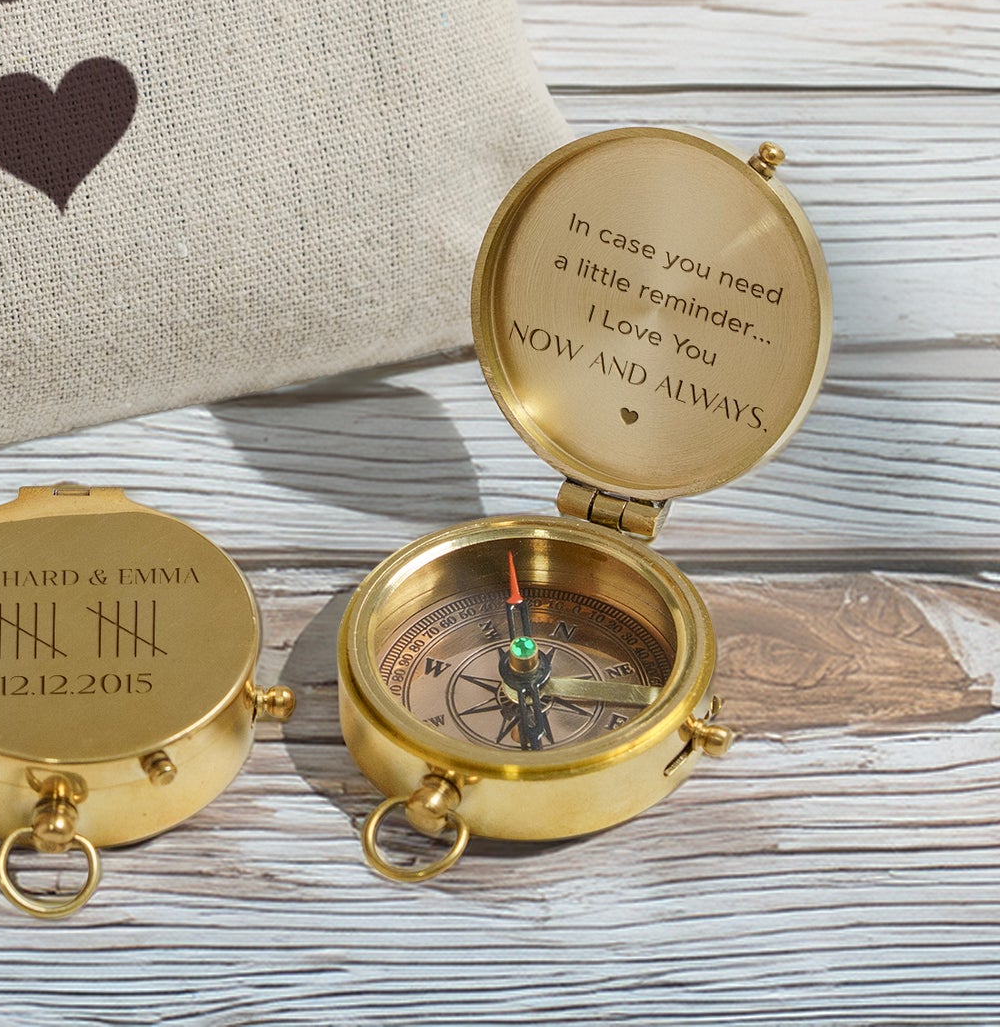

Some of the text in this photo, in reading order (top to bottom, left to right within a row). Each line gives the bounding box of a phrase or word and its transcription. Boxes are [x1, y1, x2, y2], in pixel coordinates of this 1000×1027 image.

[569, 213, 783, 306] In case you need
[554, 255, 771, 345] a little reminder...
[588, 305, 717, 367] I Love You
[508, 320, 768, 433] NOW AND ALWAYS.
[88, 569, 108, 586] &
[119, 567, 200, 585] EMMA
[439, 616, 457, 628] 60
[549, 620, 578, 641] N
[422, 626, 440, 639] 70
[408, 639, 425, 653] 80
[398, 653, 414, 667] 90
[424, 657, 452, 678] W
[391, 668, 406, 682] 80
[604, 662, 636, 679] NE
[0, 673, 153, 696] 12.12.2015
